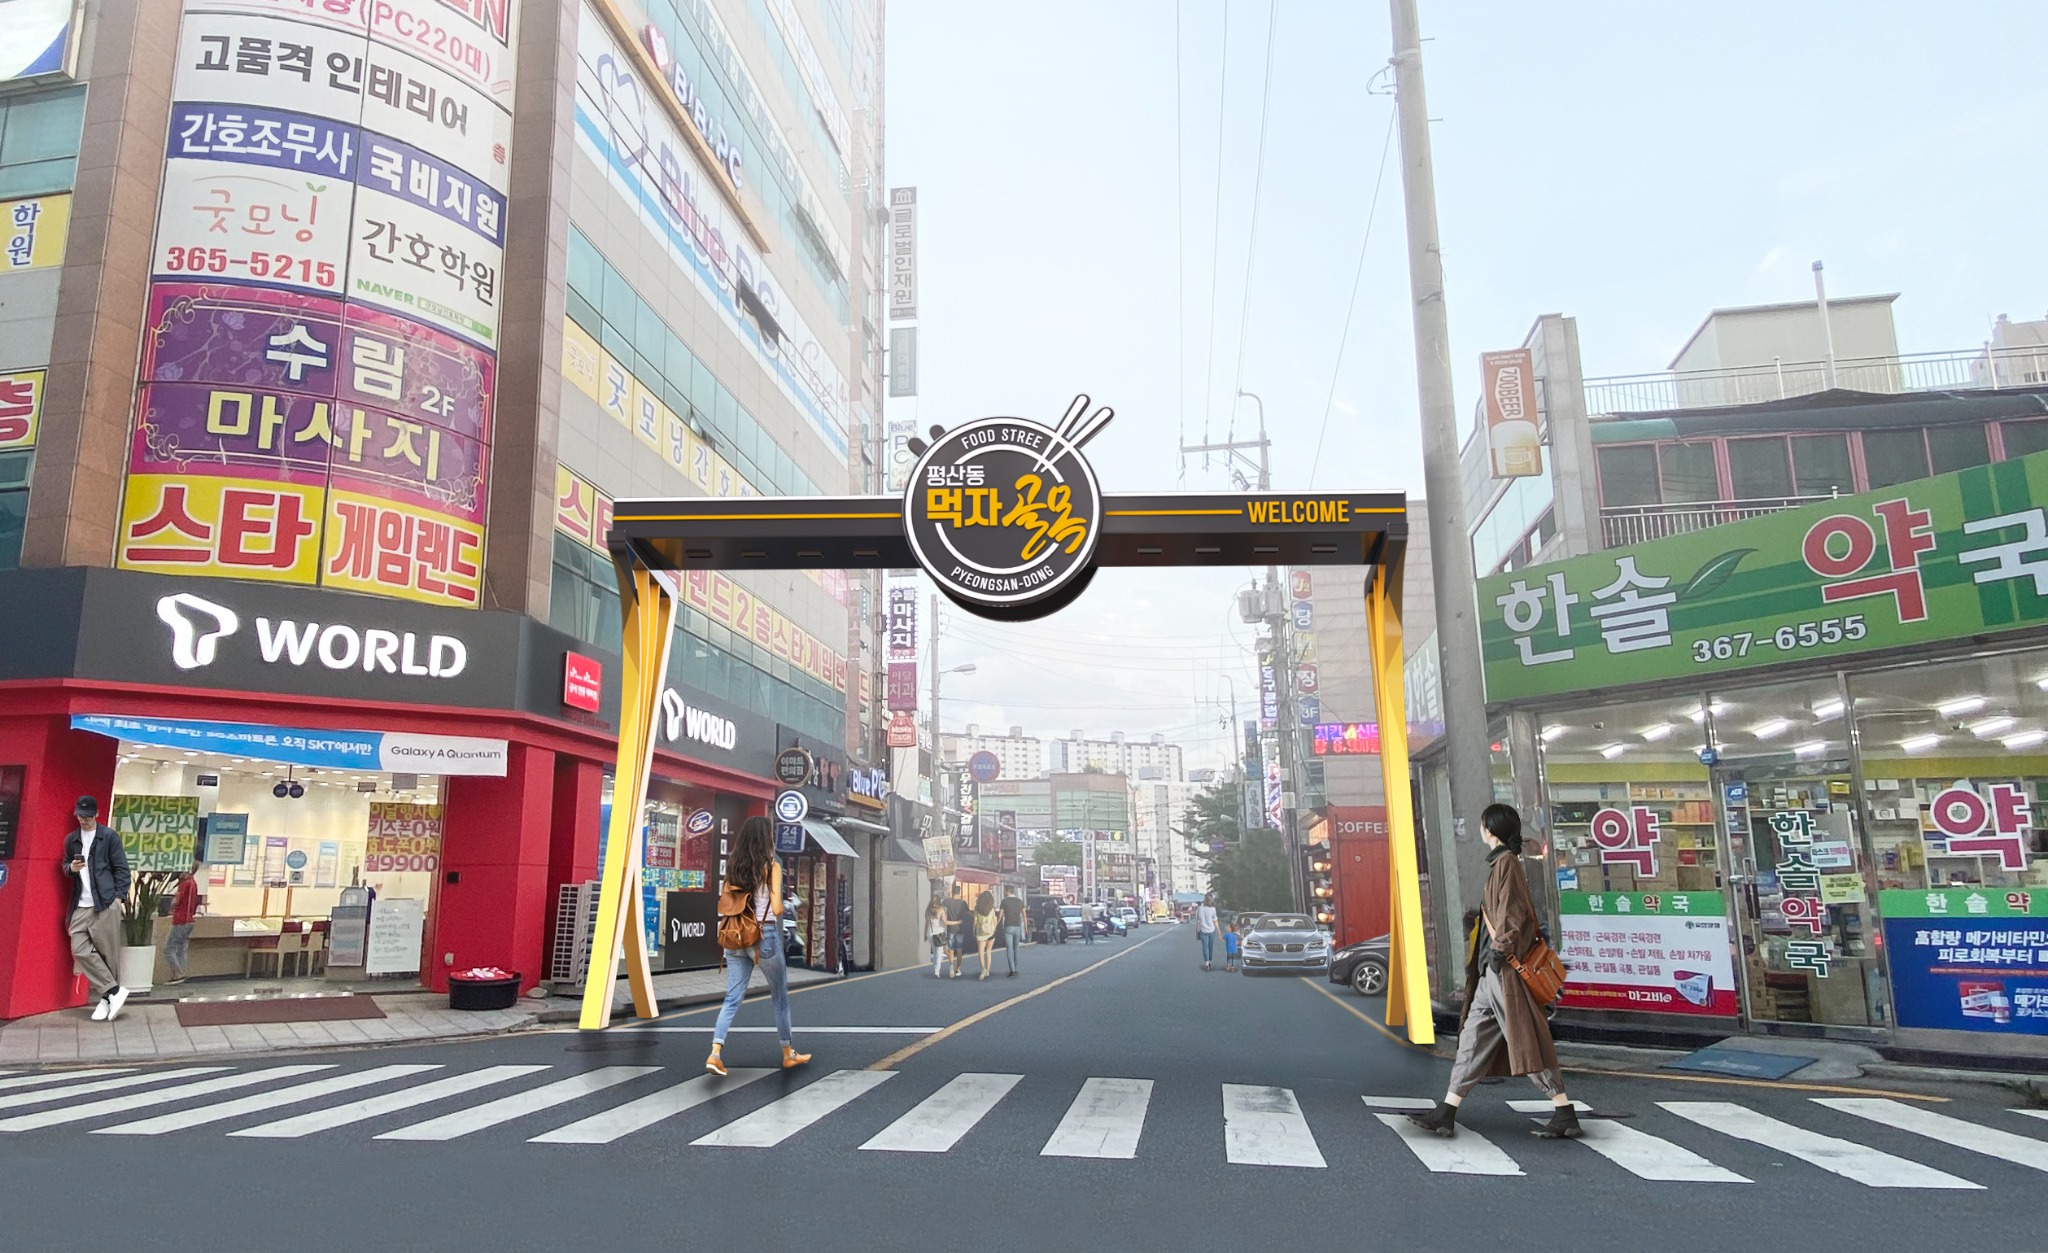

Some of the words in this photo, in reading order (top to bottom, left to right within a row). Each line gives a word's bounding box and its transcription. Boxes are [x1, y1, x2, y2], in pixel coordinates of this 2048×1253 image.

[195, 35, 313, 83] 고품격
[326, 52, 468, 137] 인테리어
[180, 112, 353, 175] 간호조무사
[370, 144, 500, 240] 국비지원
[8, 203, 41, 266] 학원
[192, 187, 319, 244] 굿모닝
[166, 245, 336, 288] 365-5215
[361, 218, 496, 307] 간호학원
[356, 278, 415, 306] NAVER
[266, 322, 403, 400] 수림
[420, 384, 456, 418] 2F
[1498, 368, 1521, 417] 700BEER
[206, 390, 441, 482] 마사지
[960, 428, 996, 450] FOOD
[926, 465, 985, 487] 평산동
[926, 487, 1003, 529] 먹자
[1001, 473, 1088, 561] 골목
[1246, 499, 1351, 524] WELCOME
[125, 486, 314, 570] 스타
[330, 501, 479, 602] 게임랜드
[950, 565, 1055, 592] PYEONGSAN-DONG
[1496, 555, 1678, 668] 한솔
[1801, 497, 2048, 625] 약국
[255, 617, 468, 679] WORLD
[892, 603, 914, 648] 마사지
[1691, 614, 1868, 664] 367-6555
[889, 683, 915, 699] 치과
[1301, 706, 1319, 719] 3F
[281, 736, 306, 751] 오직
[307, 738, 374, 757] SKT에서만
[686, 706, 736, 751] WORLD
[391, 746, 436, 759] Galaxy
[437, 749, 445, 758] A
[446, 749, 501, 760] Quantum
[852, 768, 870, 796] Blue
[871, 767, 887, 800] PC
[367, 836, 439, 855] 효도폰0원
[368, 819, 441, 837] 키즈폰0원
[783, 826, 798, 836] 24
[1591, 806, 1660, 877] 약
[1930, 783, 2033, 871] 약
[366, 854, 438, 872] 월9900
[1768, 811, 1831, 979] 한솔약국
[681, 922, 705, 938] WORLD
[1937, 947, 2033, 965] 피로회복부터
